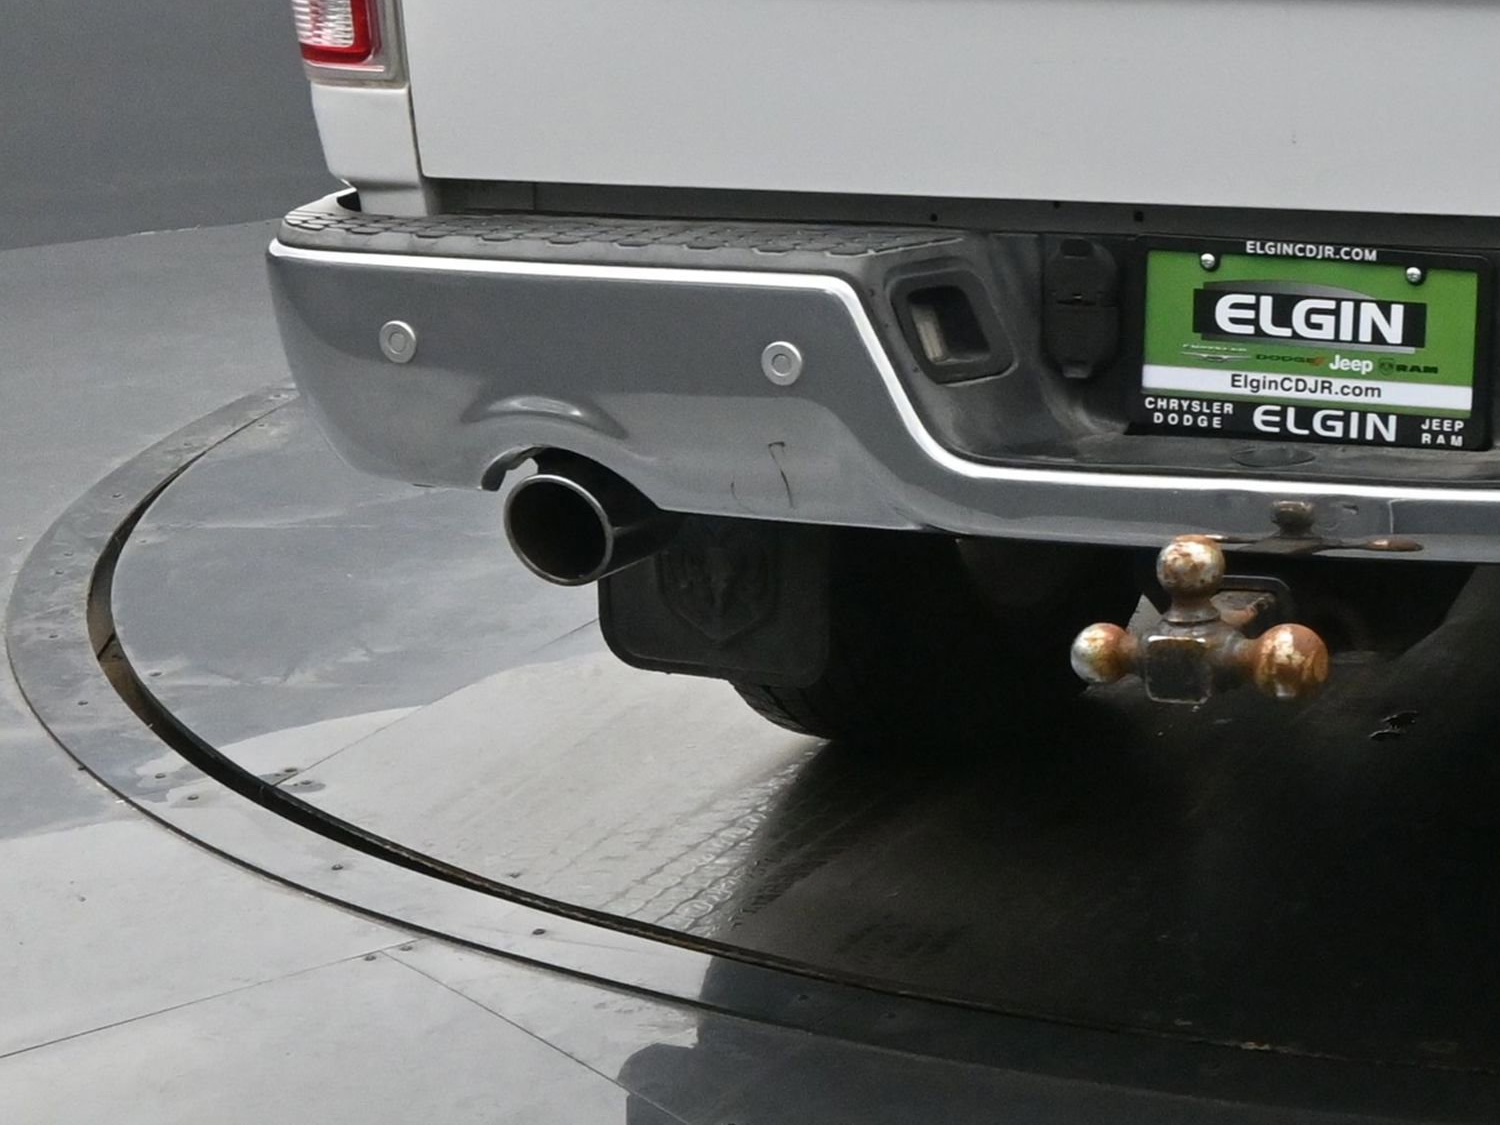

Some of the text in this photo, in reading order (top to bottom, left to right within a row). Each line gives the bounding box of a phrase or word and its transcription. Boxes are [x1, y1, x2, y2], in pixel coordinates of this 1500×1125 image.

[1245, 240, 1378, 262] ELGINCDJR.COM
[1214, 293, 1405, 344] ELGIN
[1329, 354, 1374, 375] Jeep
[1395, 364, 1439, 375] RAM
[1230, 373, 1383, 399] ElginCDJR.com
[1144, 396, 1234, 415] CHRYSLER
[1153, 411, 1223, 429] DODGE
[1252, 404, 1398, 443] ELGIN
[1420, 417, 1465, 433] JEEP
[1421, 432, 1464, 447] RAM
